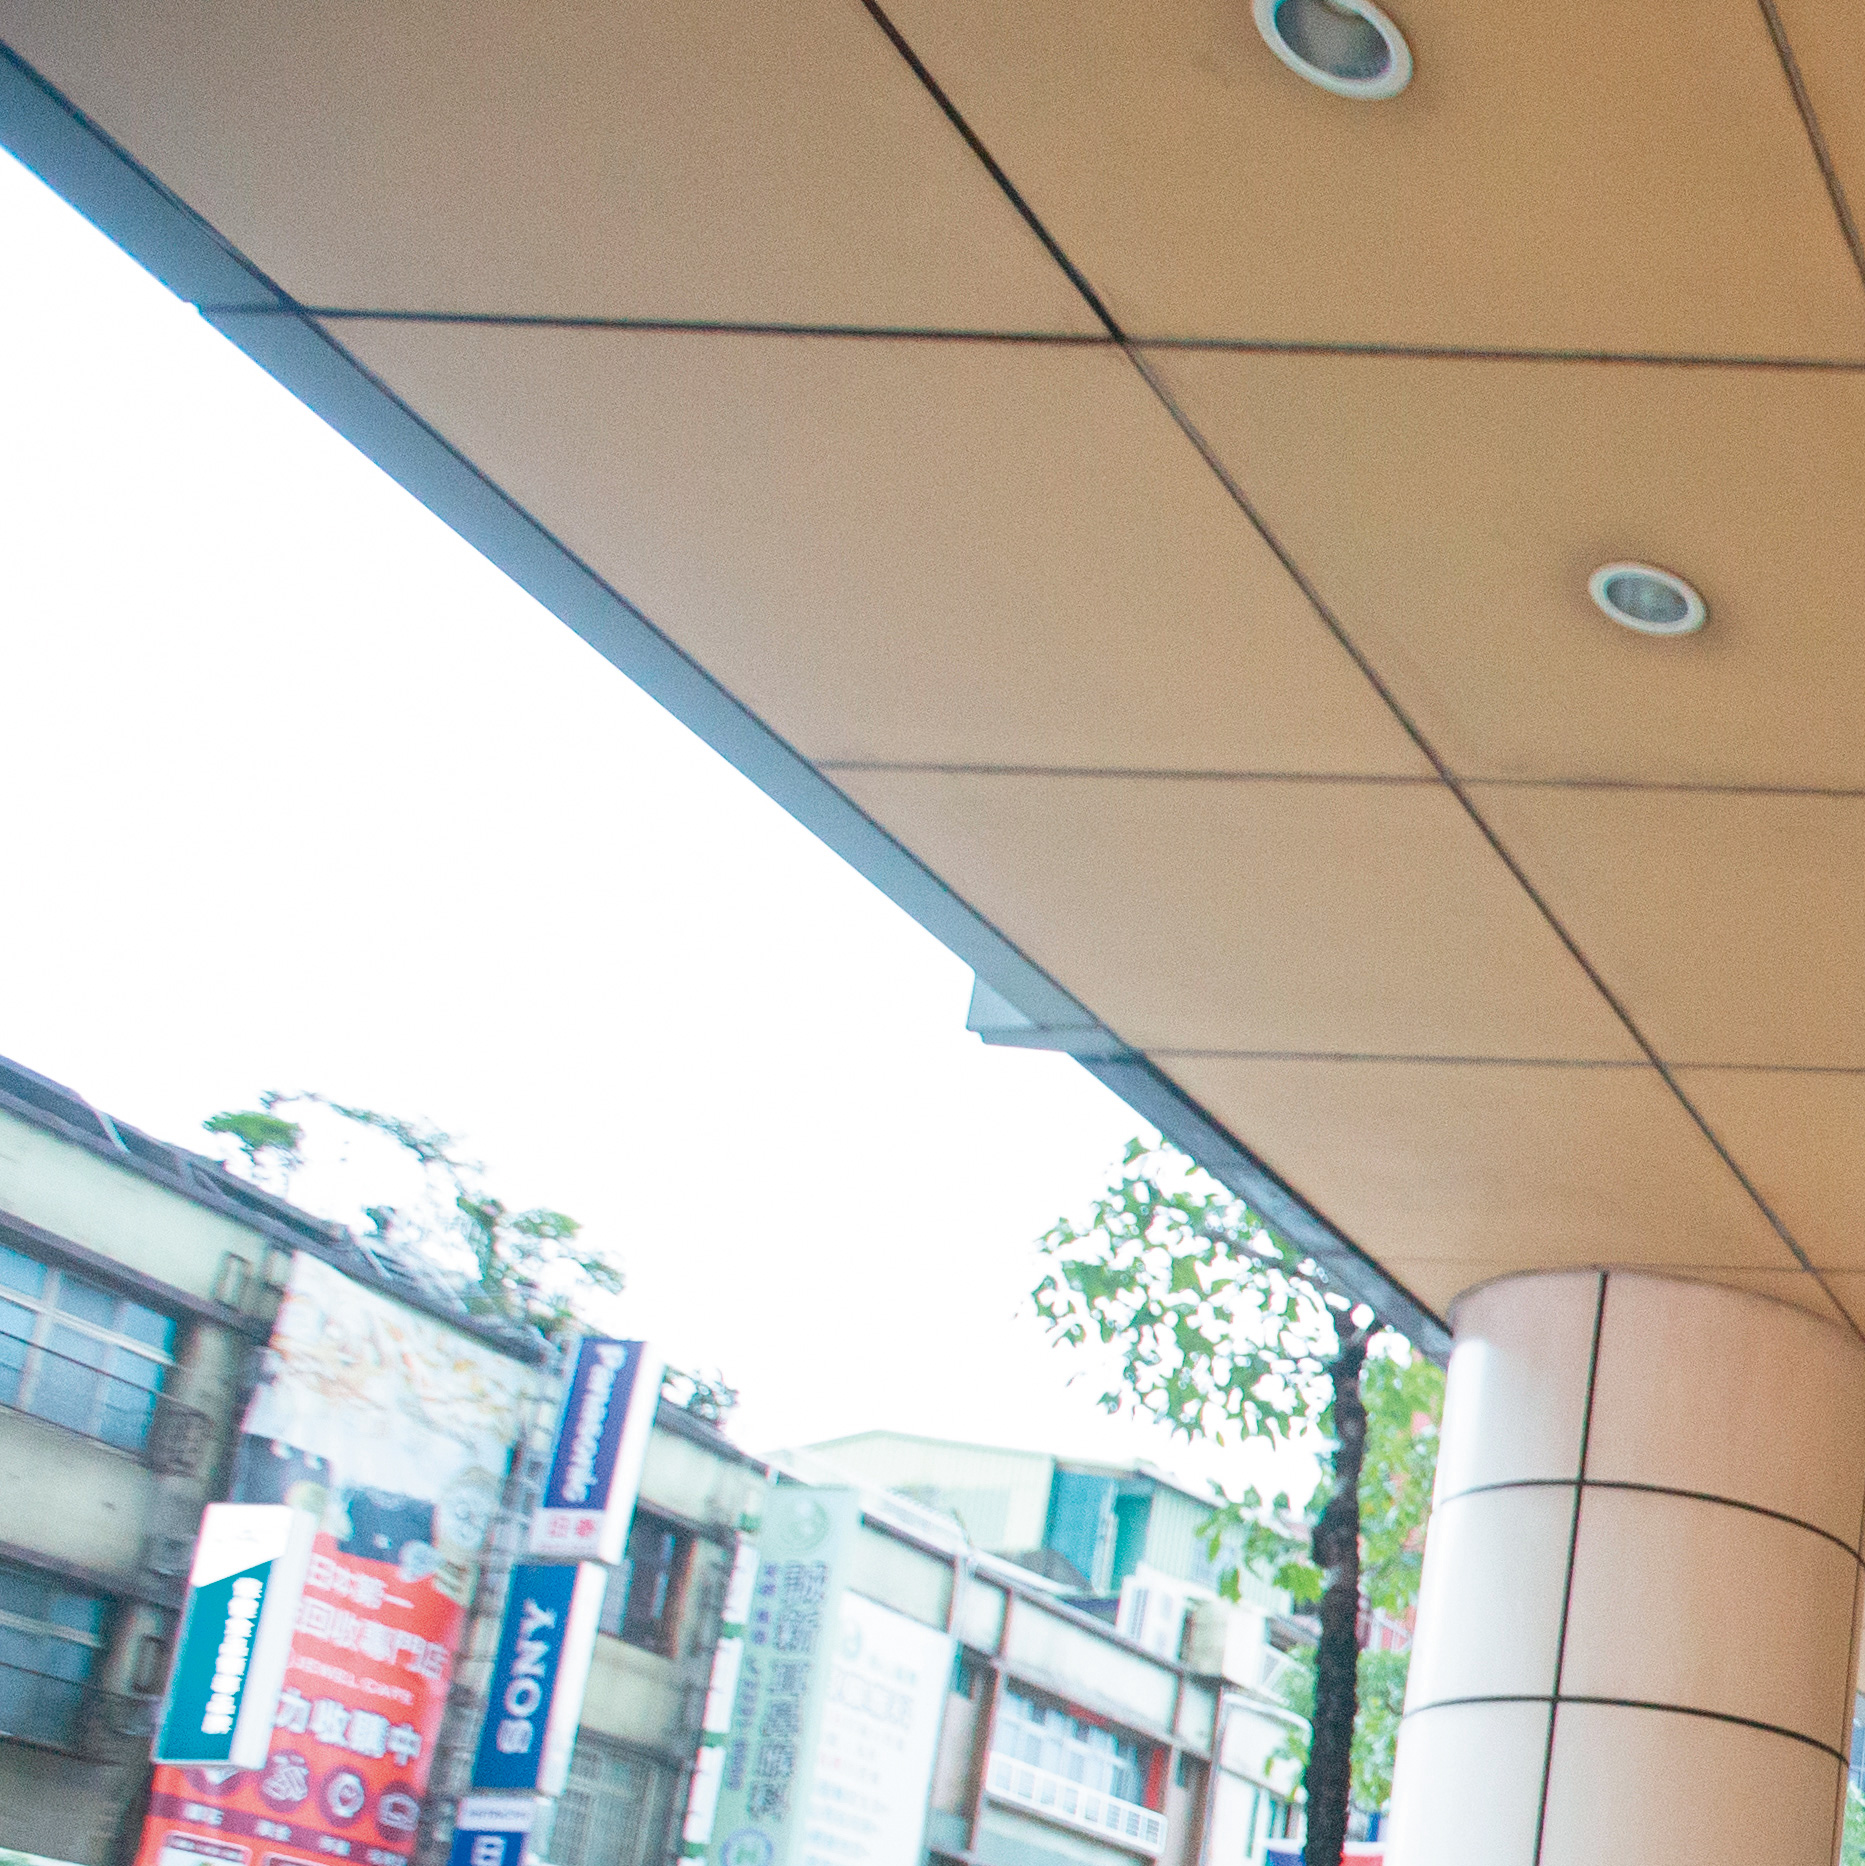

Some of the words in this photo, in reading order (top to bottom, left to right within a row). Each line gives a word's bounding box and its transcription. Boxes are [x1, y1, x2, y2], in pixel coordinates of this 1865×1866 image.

[296, 1596, 449, 1680] 回收專門店
[497, 1599, 557, 1755] SONY
